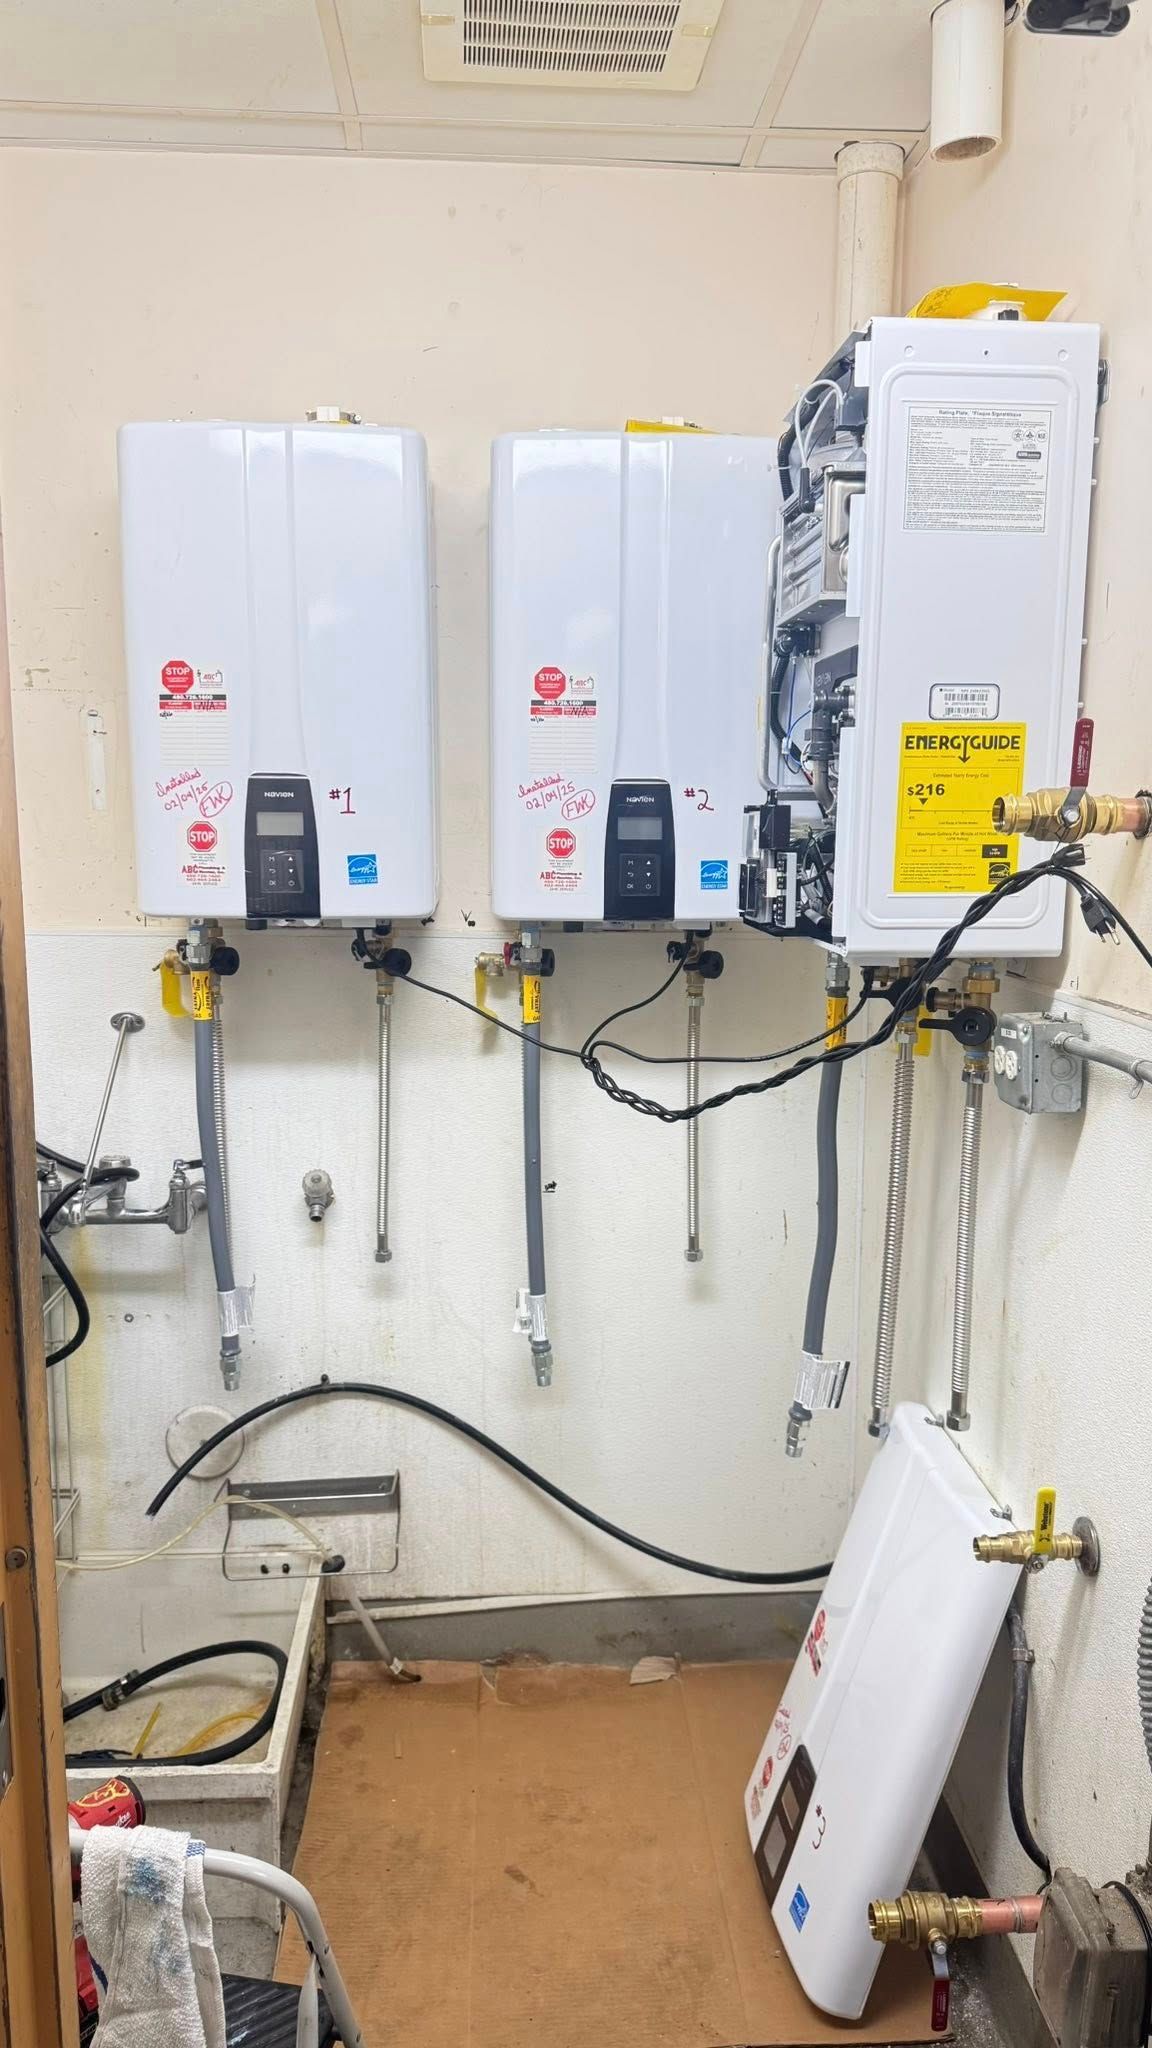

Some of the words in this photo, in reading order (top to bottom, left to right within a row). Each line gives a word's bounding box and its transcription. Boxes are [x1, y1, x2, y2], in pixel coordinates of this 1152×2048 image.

[166, 667, 190, 676] STOP
[539, 674, 563, 682] STOP
[905, 735, 1021, 754] ENERGYGUIDE
[156, 768, 201, 797] Installed
[518, 773, 565, 798] Installed
[907, 783, 945, 796] $216
[329, 787, 356, 814] #1
[684, 787, 715, 811] #2
[190, 831, 215, 843] STOP
[549, 838, 573, 849] STOP
[182, 864, 199, 874] ABC
[540, 870, 556, 880] ABC
